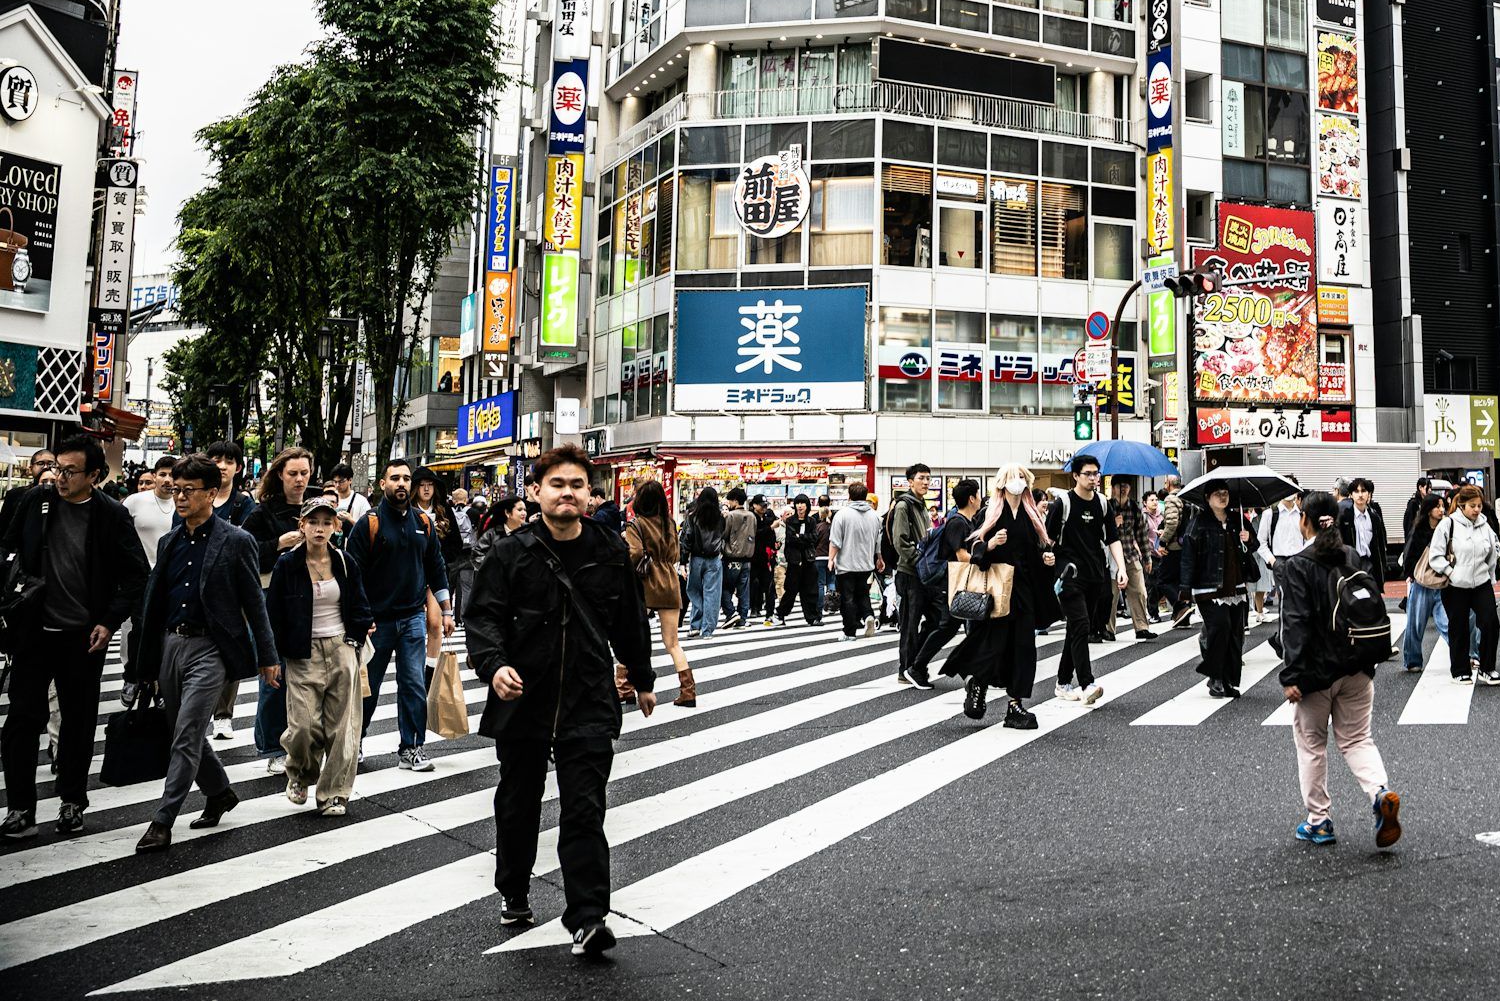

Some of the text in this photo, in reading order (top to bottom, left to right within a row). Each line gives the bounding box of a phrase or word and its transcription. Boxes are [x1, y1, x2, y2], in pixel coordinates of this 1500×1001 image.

[1342, 16, 1354, 27] 4F
[6, 73, 34, 113] 質
[555, 85, 582, 112] 薬
[1151, 77, 1170, 104] 薬
[113, 163, 134, 184] 質
[500, 155, 510, 166] 5F
[17, 194, 58, 216] SHOP
[552, 158, 574, 247] 肉汁水餃子
[743, 163, 801, 226] 前田屋
[1154, 156, 1169, 248] 肉汁水餃子
[34, 229, 53, 239] OMEGA
[35, 220, 53, 230] ROLEX
[33, 240, 53, 250] CARTIER
[105, 191, 129, 304] 質・買取・販売
[1333, 207, 1350, 278] 日高屋
[546, 264, 568, 329] レイク
[734, 298, 803, 375] 薬
[725, 387, 812, 404] ミネドラッグ
[1258, 412, 1309, 439] 日高屋
